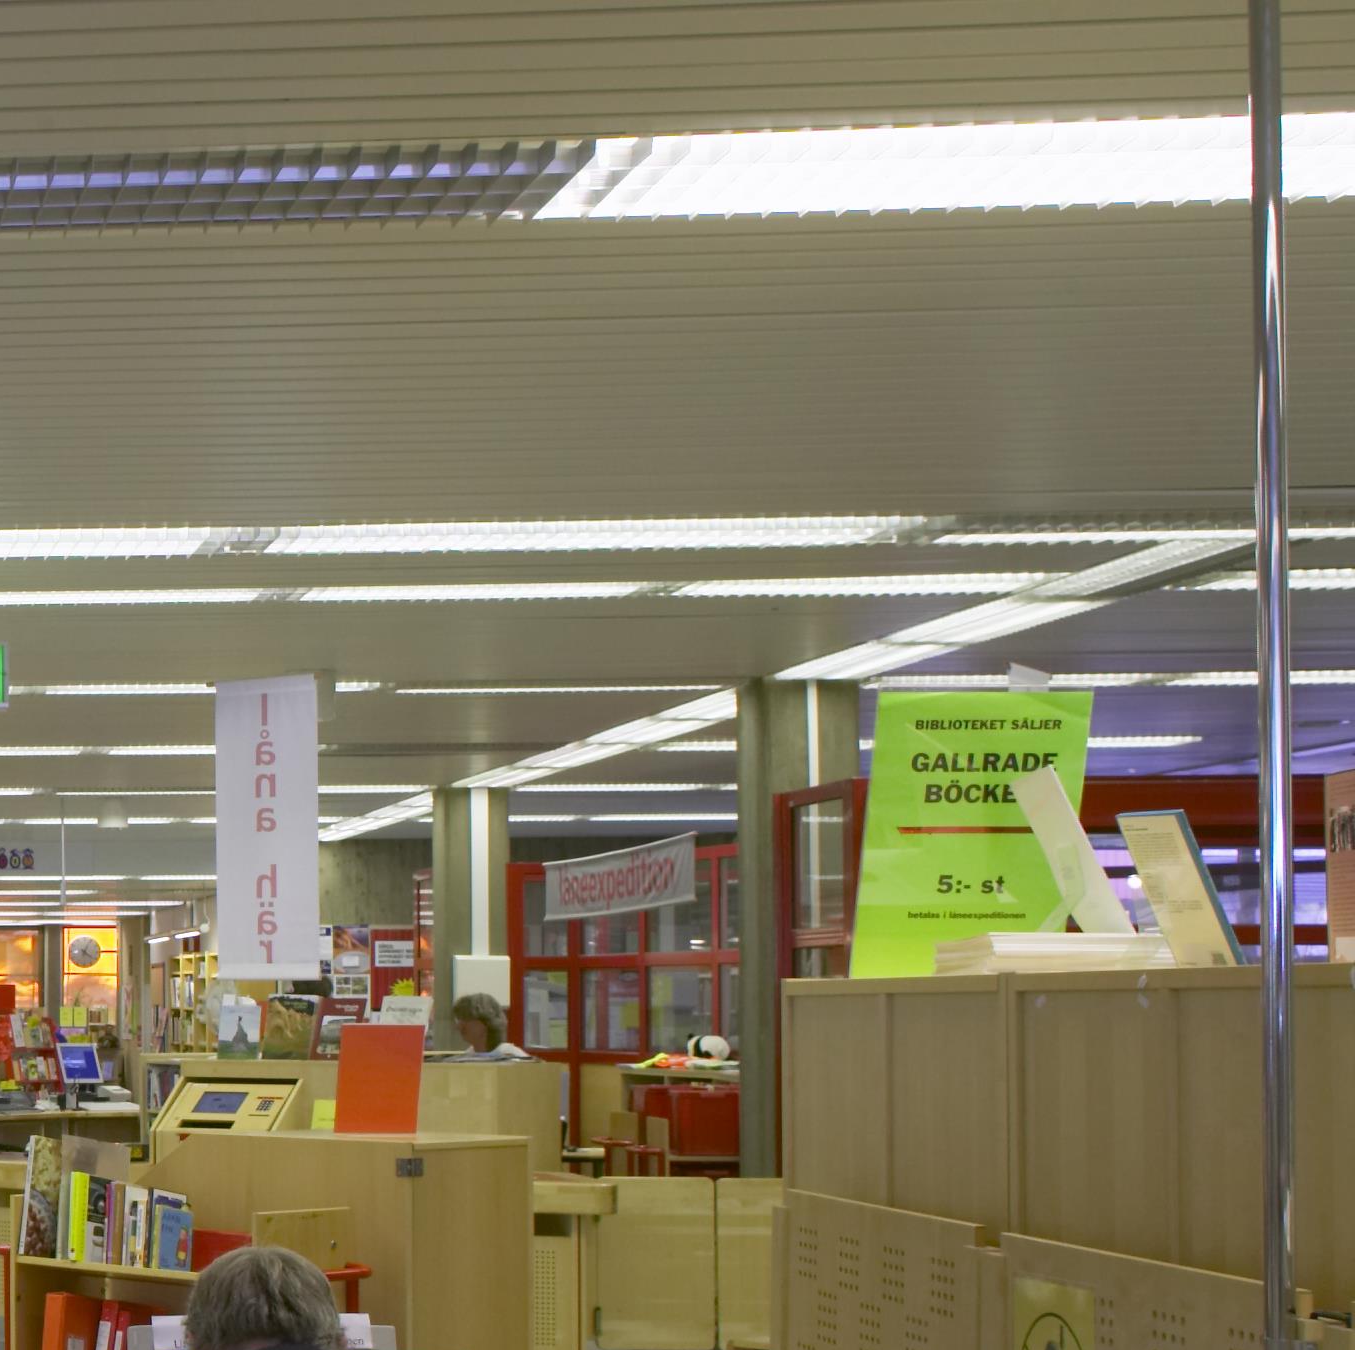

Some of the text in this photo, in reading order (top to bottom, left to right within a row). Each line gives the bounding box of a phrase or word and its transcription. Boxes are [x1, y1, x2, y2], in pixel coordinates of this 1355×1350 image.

[914, 718, 1062, 730] BIBLIOTEKET SÄLJER
[923, 779, 1018, 804] BÖCKE
[936, 874, 1005, 894] 5:- st
[907, 911, 941, 919] betalas
